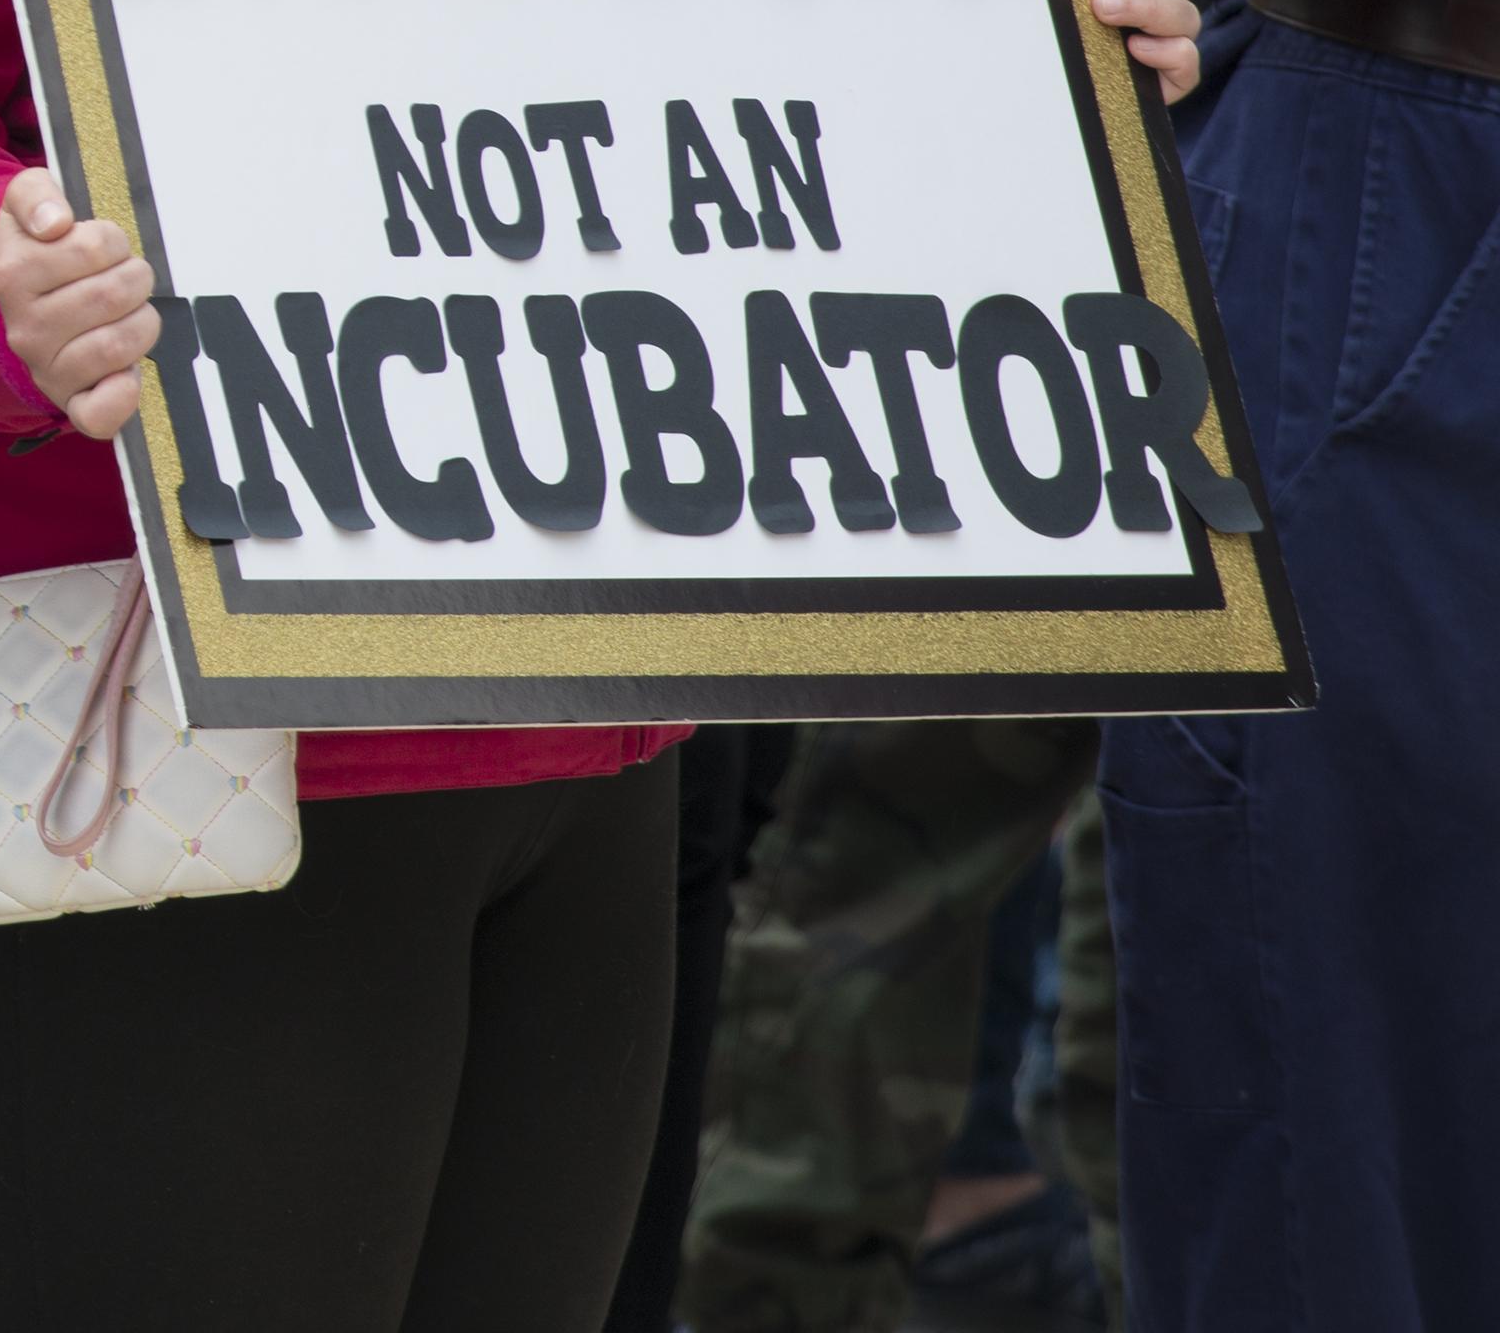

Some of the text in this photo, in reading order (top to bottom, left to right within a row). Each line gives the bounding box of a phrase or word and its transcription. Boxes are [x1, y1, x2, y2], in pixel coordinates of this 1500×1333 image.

[365, 97, 842, 261] NOT AN
[146, 289, 1269, 541] INCUBATOR
